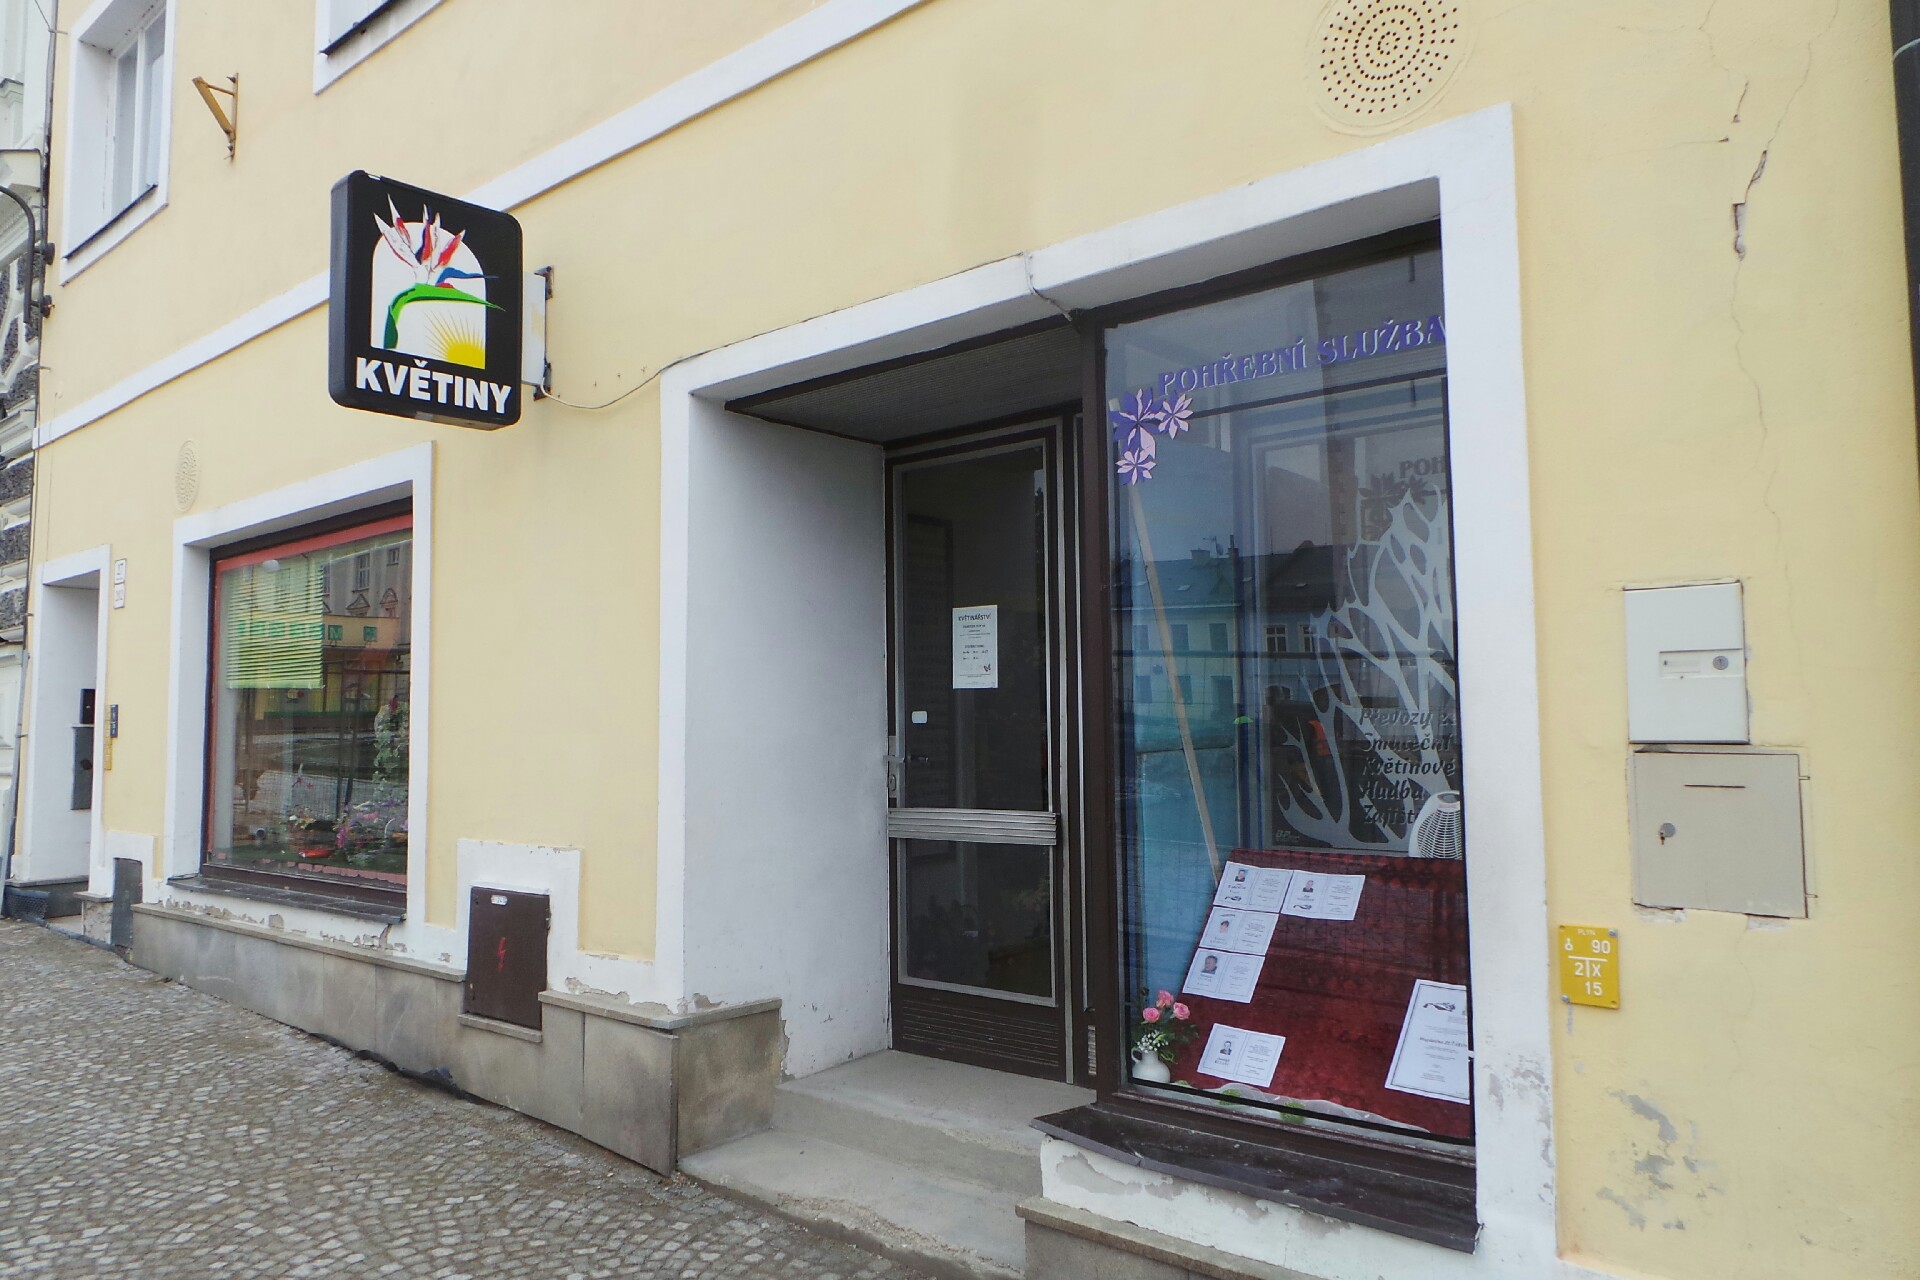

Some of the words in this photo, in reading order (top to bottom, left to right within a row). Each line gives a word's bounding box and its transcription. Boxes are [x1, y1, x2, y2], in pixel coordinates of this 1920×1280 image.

[1157, 336, 1307, 397] POHŘEBNÍ
[1316, 314, 1446, 366] SLUŽBA
[355, 357, 513, 415] KVĚTINY
[1591, 939, 1611, 954] 90
[1585, 981, 1603, 996] 15
